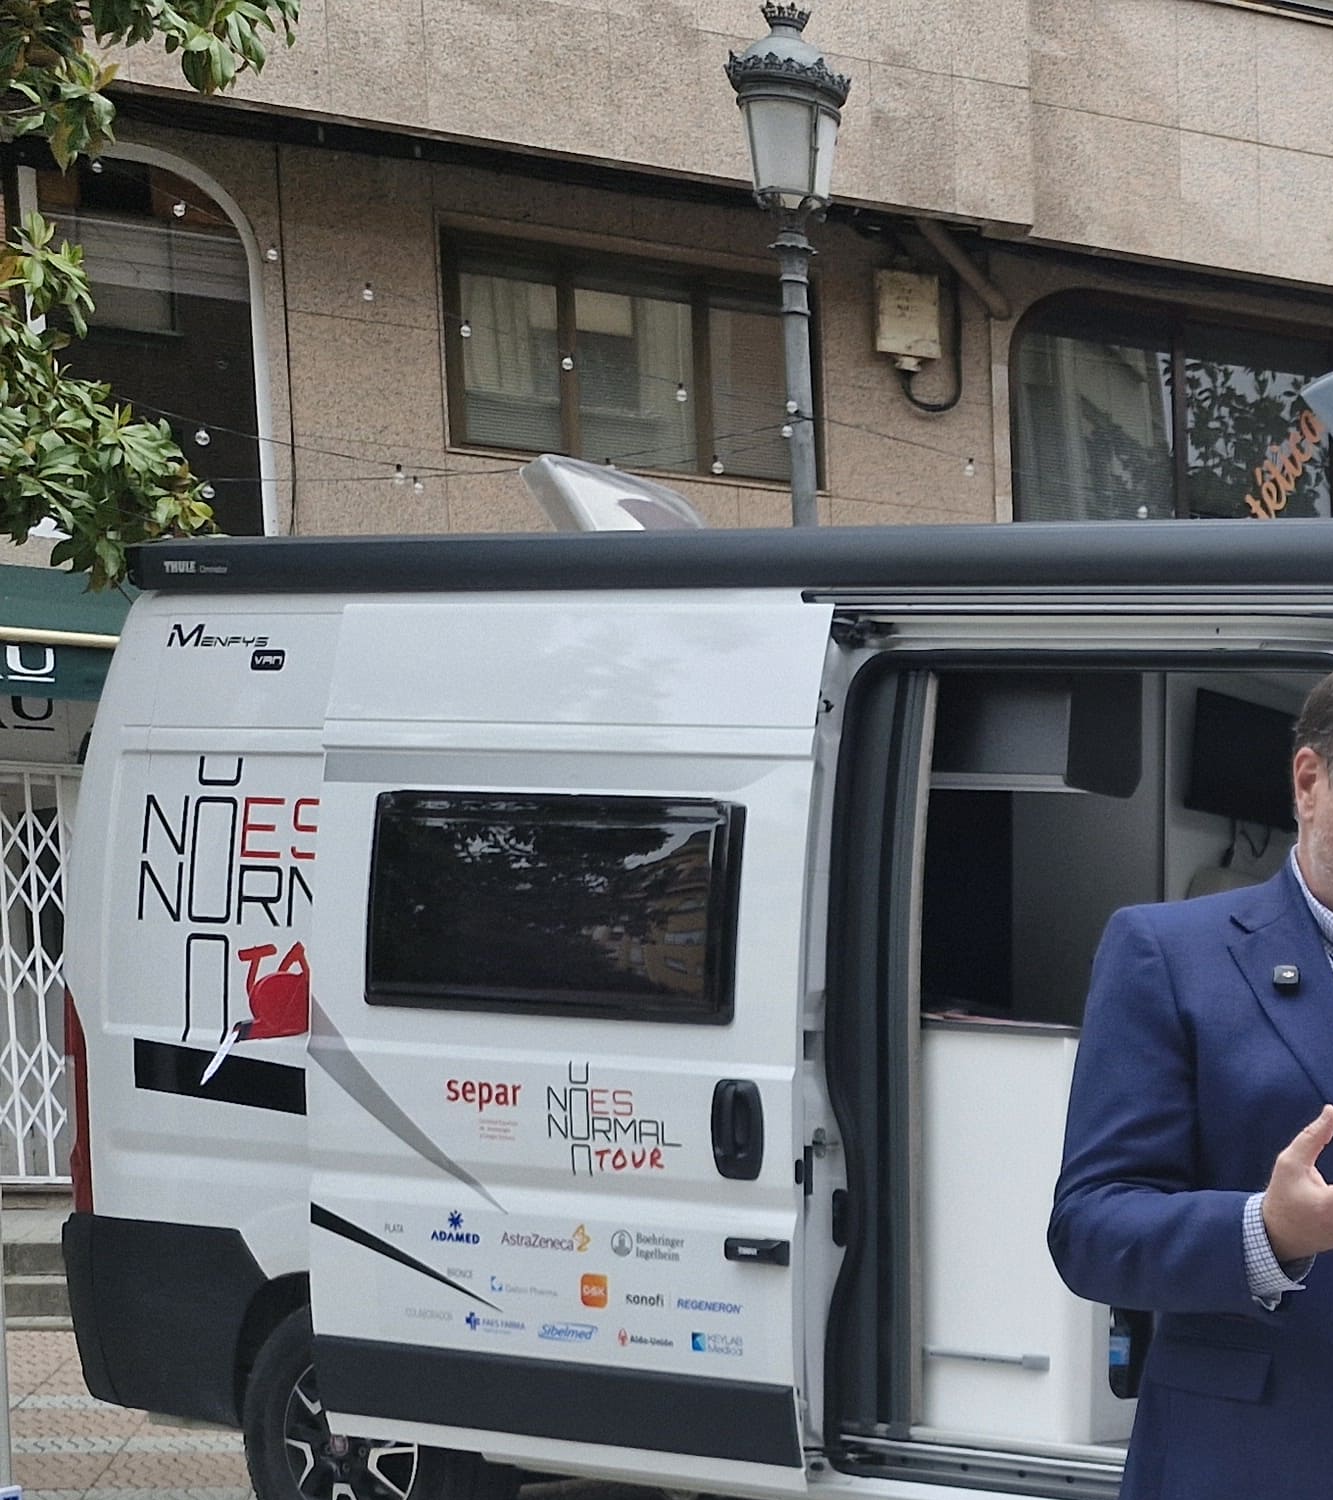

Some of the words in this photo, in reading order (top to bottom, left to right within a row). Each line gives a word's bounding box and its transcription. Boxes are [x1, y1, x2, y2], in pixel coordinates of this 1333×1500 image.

[163, 560, 196, 574] THULE
[446, 1079, 522, 1112] separ
[547, 1113, 682, 1148] NORMAL
[595, 1148, 665, 1172] TOUR
[431, 1230, 480, 1245] ADAMED
[501, 1231, 574, 1251] AstraZeneca
[636, 1231, 684, 1249] Boehringer
[636, 1249, 681, 1262] Ingelheim
[626, 1293, 665, 1308] sanofi
[677, 1297, 742, 1315] REGENERON
[541, 1323, 593, 1341] Sibelmed
